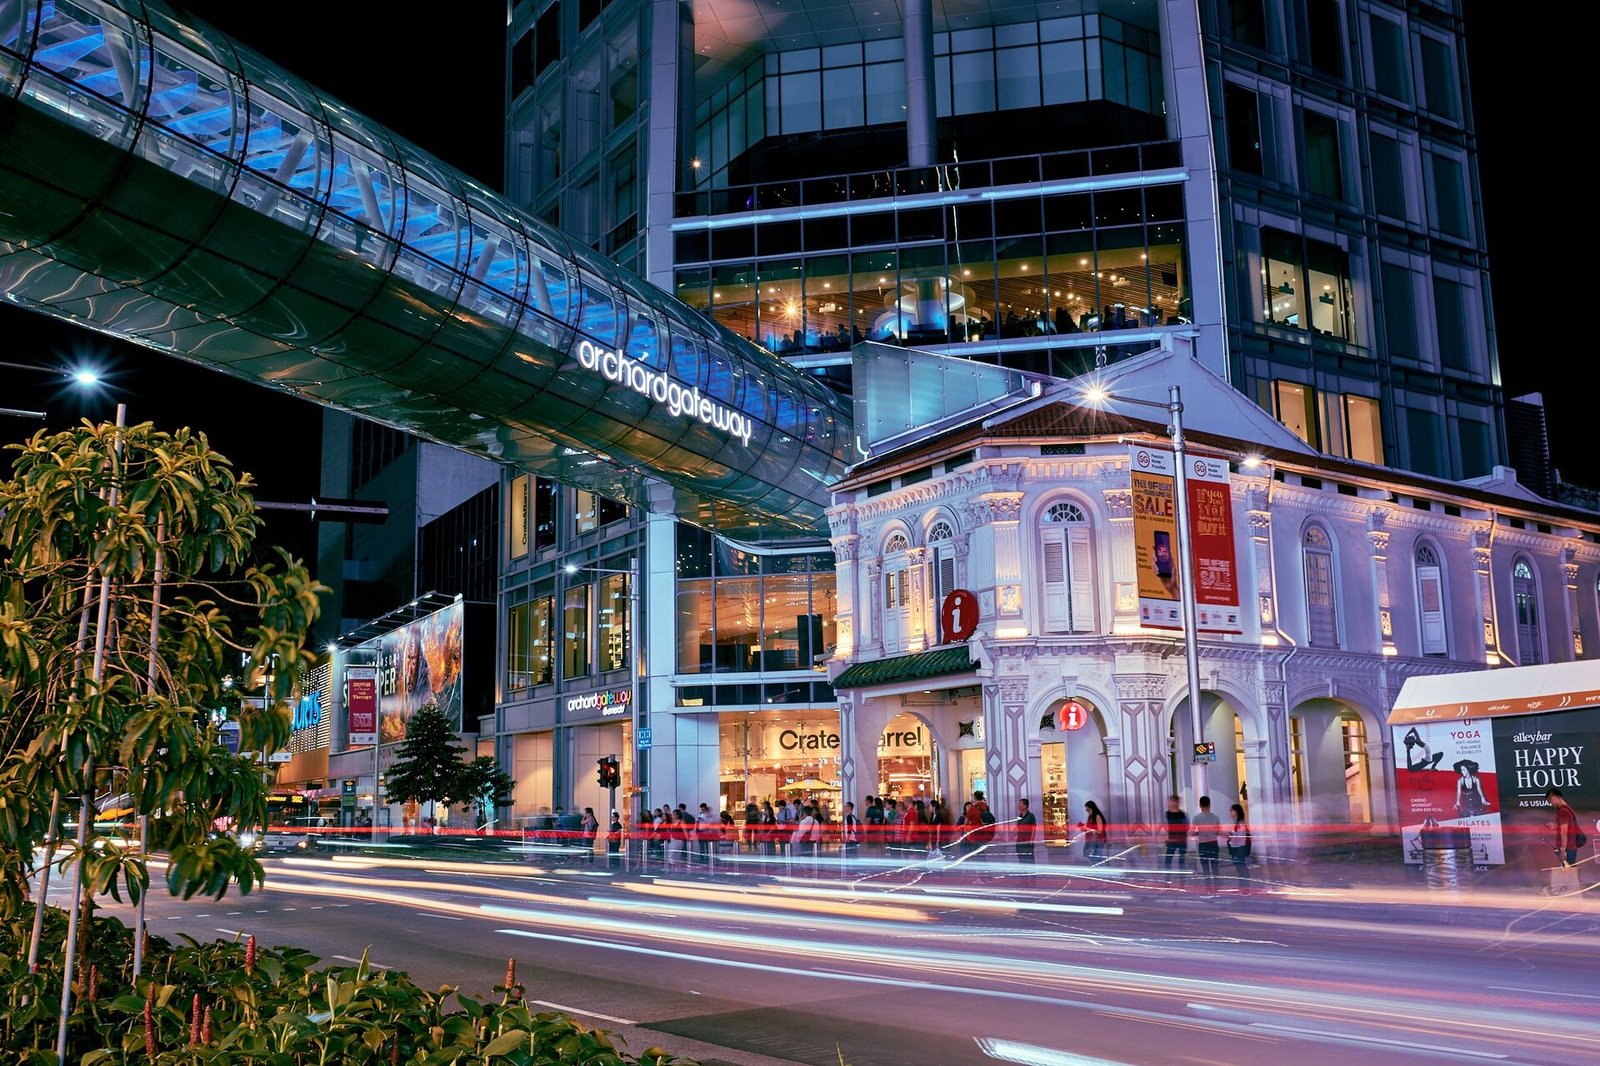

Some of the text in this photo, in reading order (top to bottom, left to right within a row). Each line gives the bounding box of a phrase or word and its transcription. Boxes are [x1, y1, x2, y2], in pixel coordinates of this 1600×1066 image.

[578, 340, 752, 447] orchardgateway
[1133, 478, 1147, 489] THE
[1134, 494, 1173, 517] SALE
[1207, 489, 1224, 504] you
[568, 690, 631, 712] orchardgateway
[779, 729, 841, 751] Crate
[881, 726, 922, 747] arrel
[1450, 730, 1481, 739] YOGA
[1513, 731, 1552, 745] alleybar
[1514, 746, 1584, 768] HAPPY
[1516, 768, 1582, 788] HOUR
